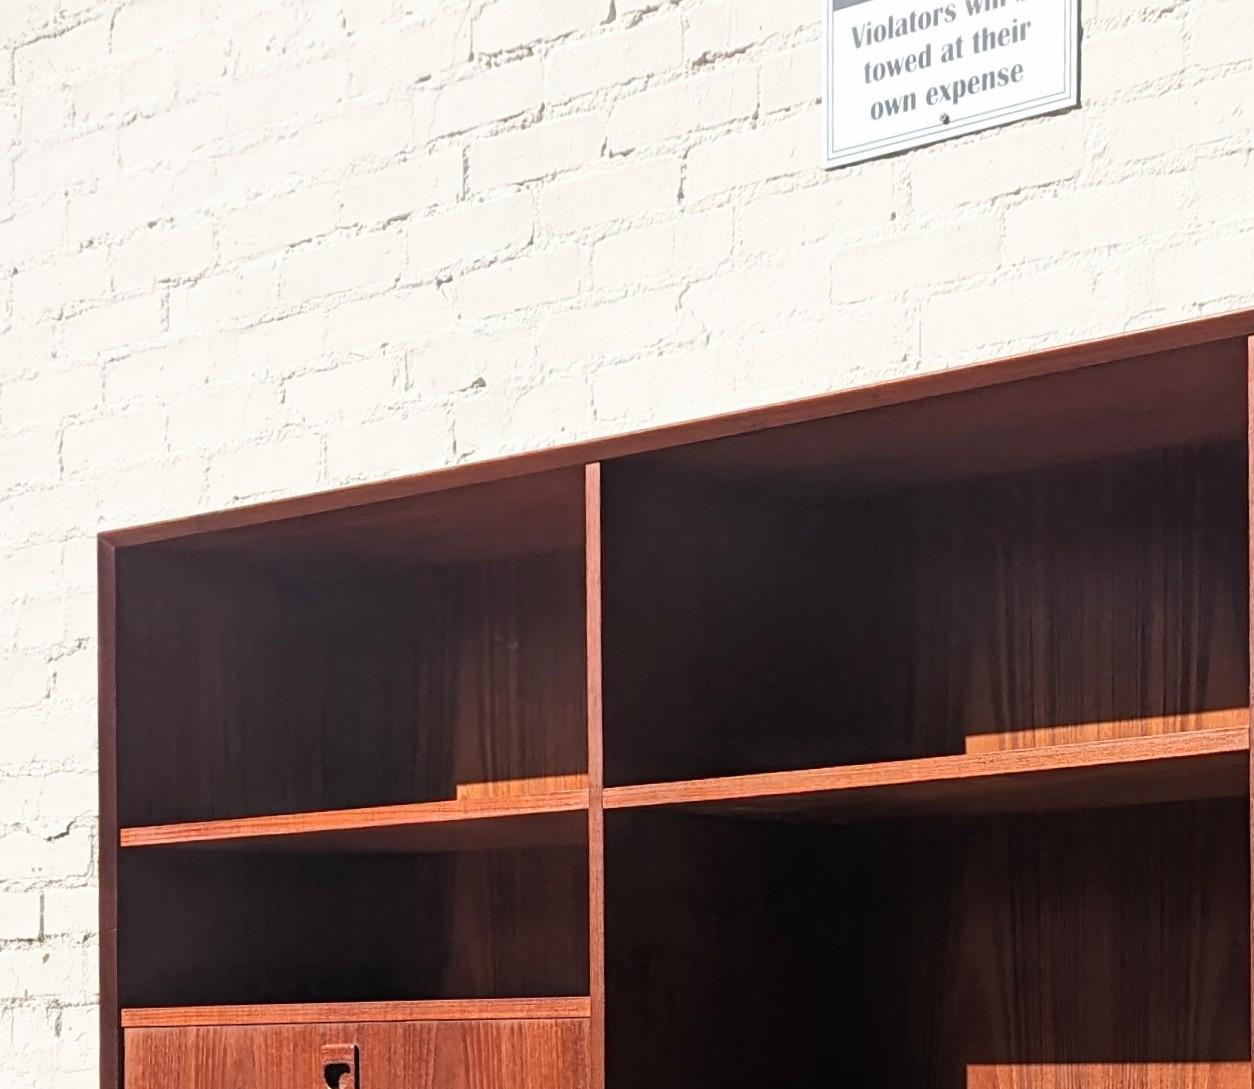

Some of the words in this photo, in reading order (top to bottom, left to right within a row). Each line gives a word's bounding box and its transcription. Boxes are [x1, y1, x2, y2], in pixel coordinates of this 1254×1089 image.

[851, 3, 957, 49] Violators
[864, 43, 932, 84] towed
[940, 36, 963, 63] at
[972, 18, 1032, 55] their
[870, 92, 917, 121] own
[925, 63, 1024, 106] expense
